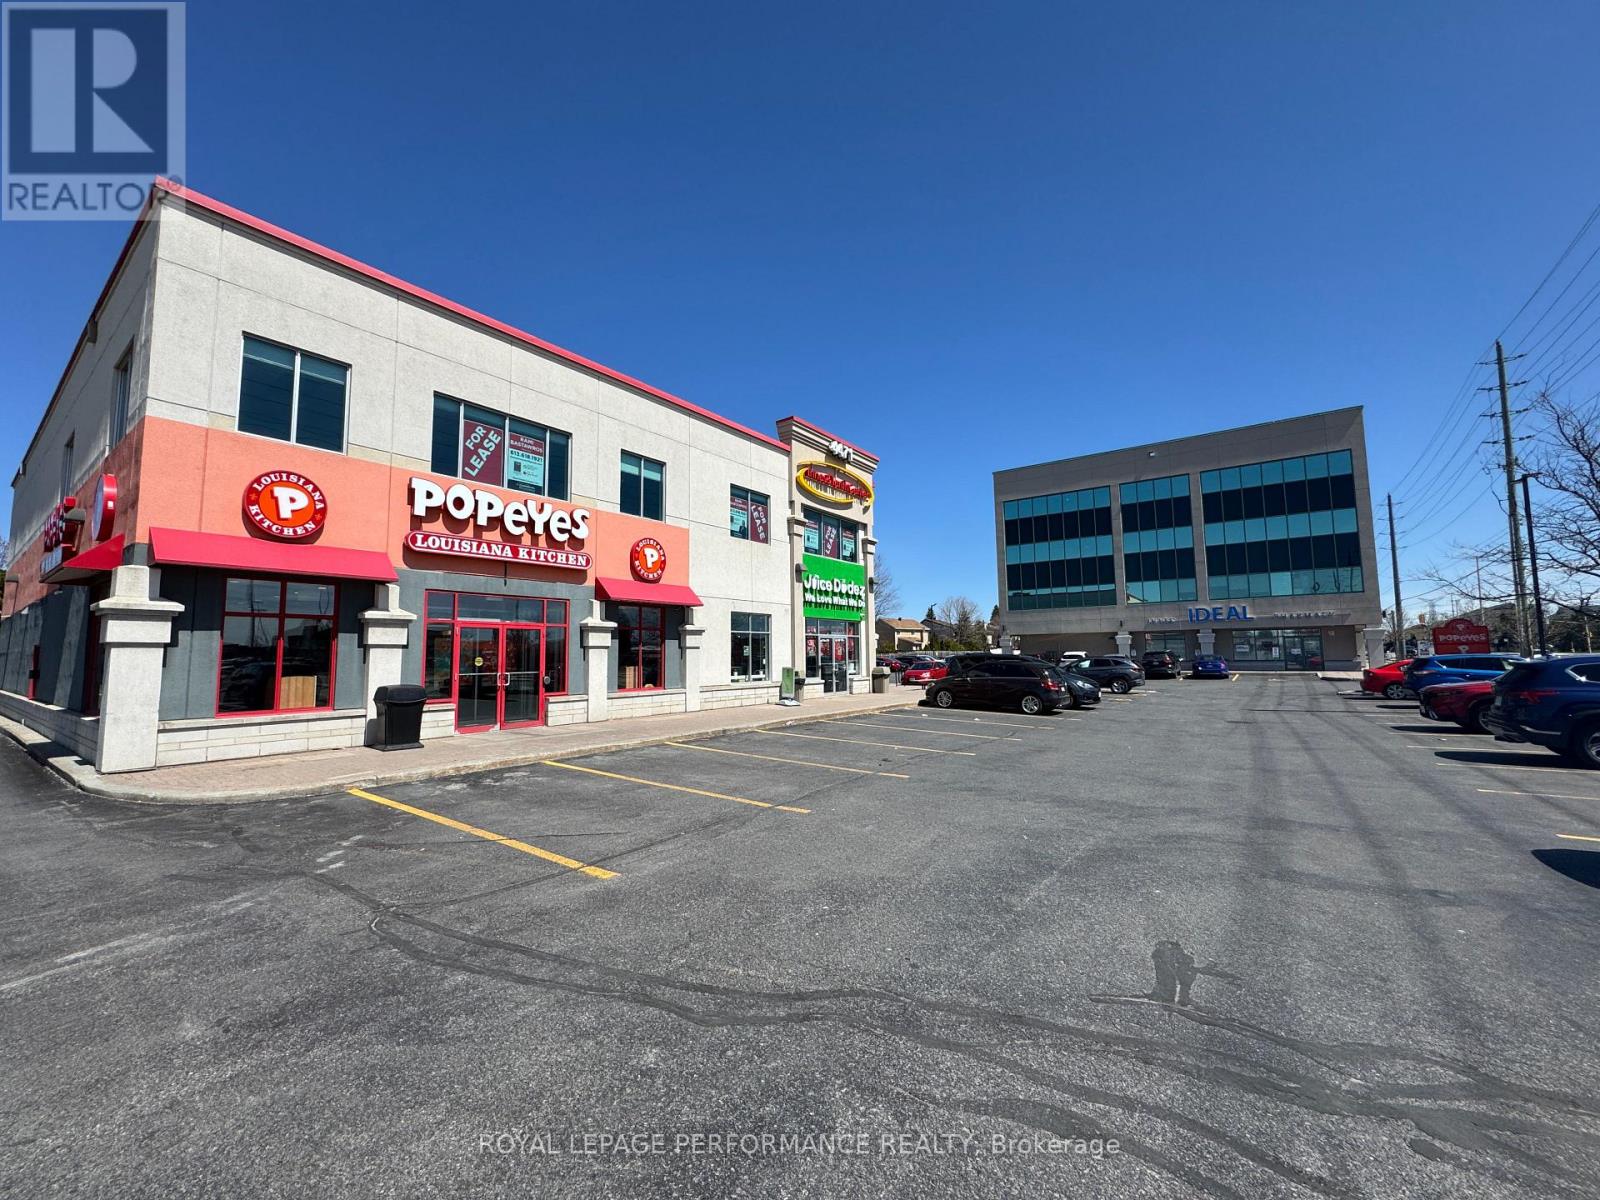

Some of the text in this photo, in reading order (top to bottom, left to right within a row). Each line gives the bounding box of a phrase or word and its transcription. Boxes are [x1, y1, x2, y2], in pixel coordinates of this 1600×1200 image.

[465, 426, 487, 450] FOR
[464, 430, 501, 477] LEASE
[253, 473, 325, 510] LOUISIANA
[273, 486, 309, 519] P
[248, 504, 316, 536] KITCHEN
[751, 505, 766, 540] LEASE
[757, 506, 766, 524] FOR
[415, 534, 588, 567] LOUISIANA KITCHEN
[636, 539, 665, 560] LOUISIANA
[644, 548, 659, 568] P
[635, 560, 662, 578] KITCHEN
[1188, 605, 1256, 624] IDEAL
